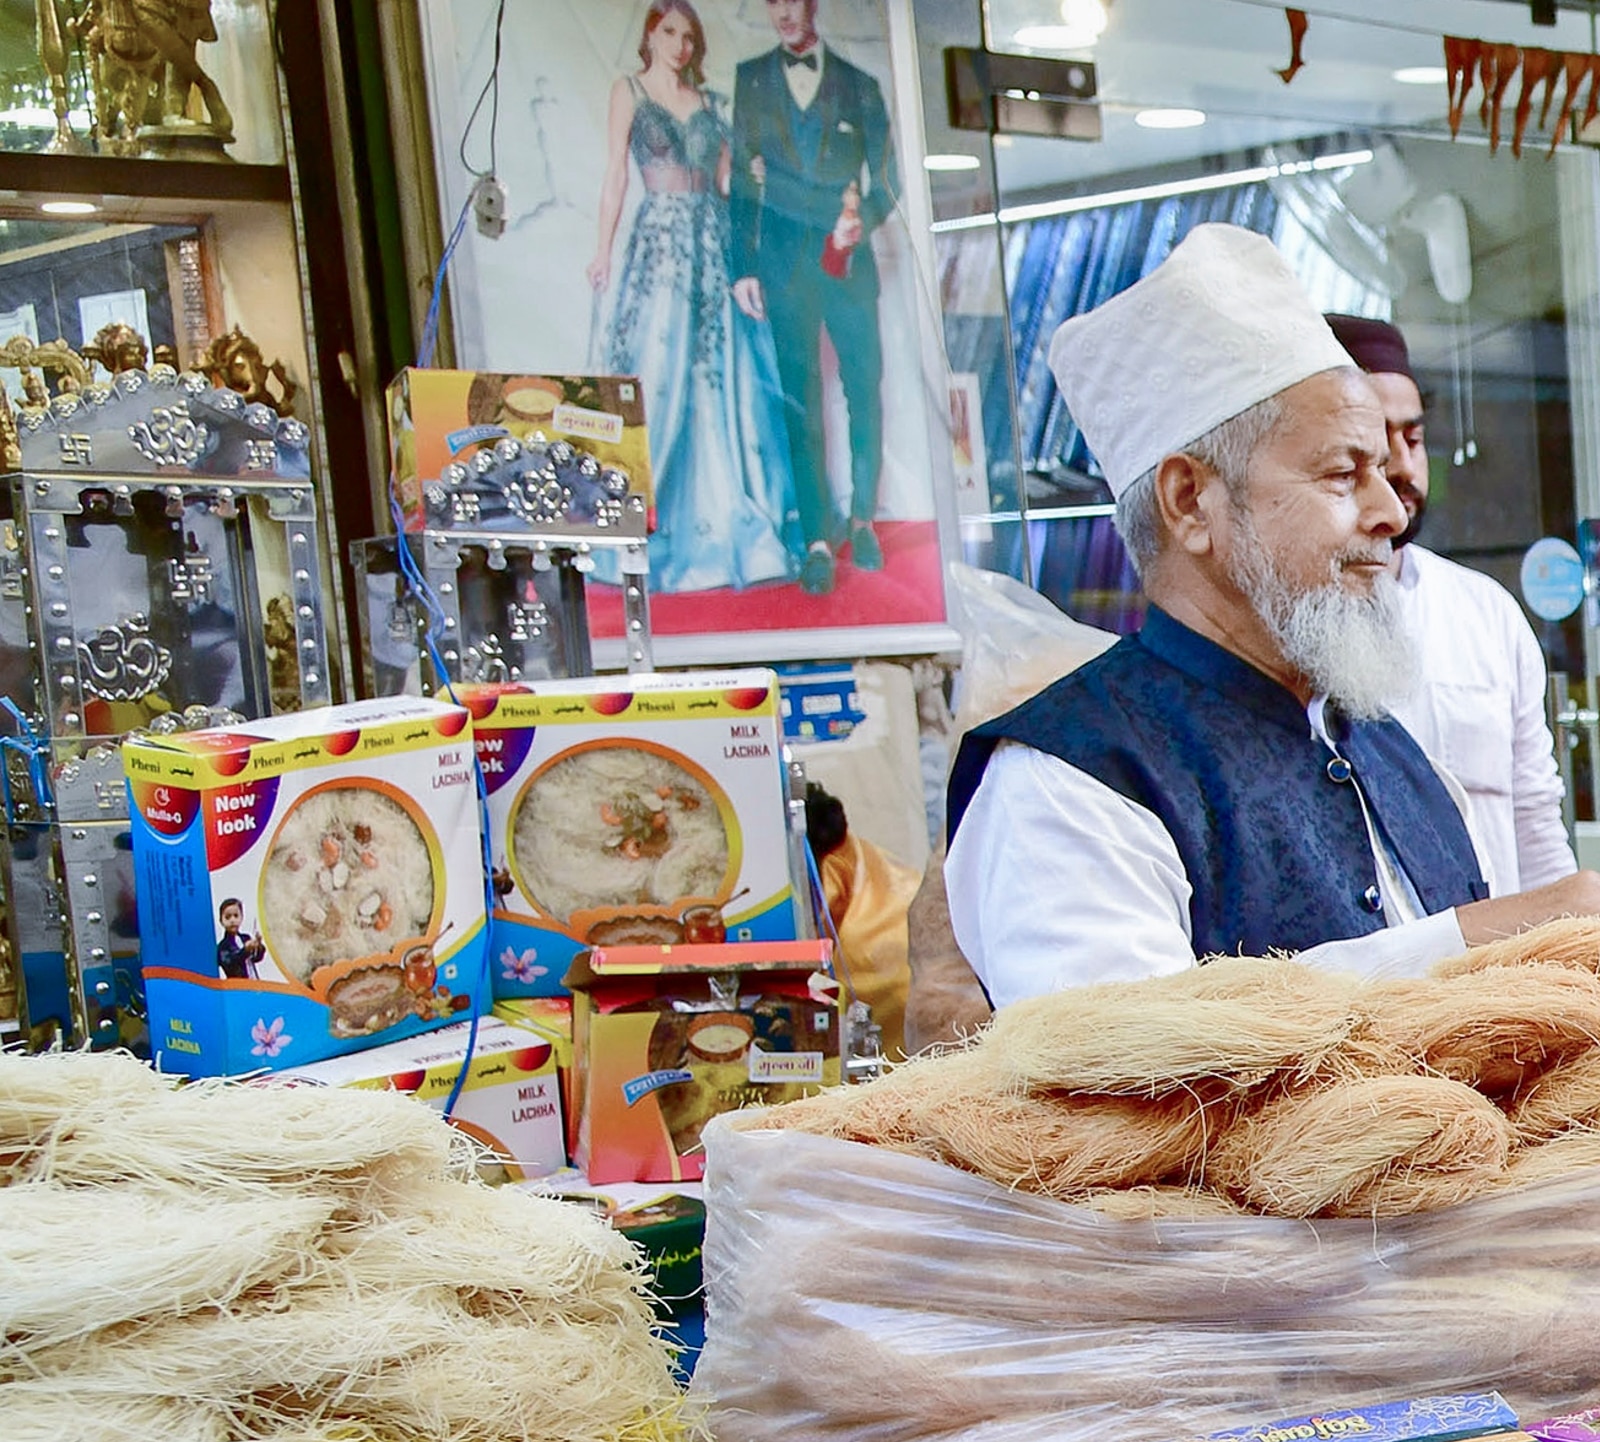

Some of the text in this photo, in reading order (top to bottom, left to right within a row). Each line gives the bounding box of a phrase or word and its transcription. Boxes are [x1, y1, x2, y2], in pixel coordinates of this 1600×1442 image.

[501, 704, 541, 718] Pheni
[637, 699, 676, 714] Pheni
[730, 725, 760, 738] MILK
[364, 735, 395, 750] Pheni
[130, 757, 161, 774] Pheni
[253, 752, 285, 770] Pheni
[438, 753, 462, 767] MILK
[215, 795, 256, 813] New
[146, 807, 182, 824] Mulla-G
[217, 815, 256, 836] look
[169, 1018, 191, 1033] MILK
[518, 1086, 546, 1101] MILK
